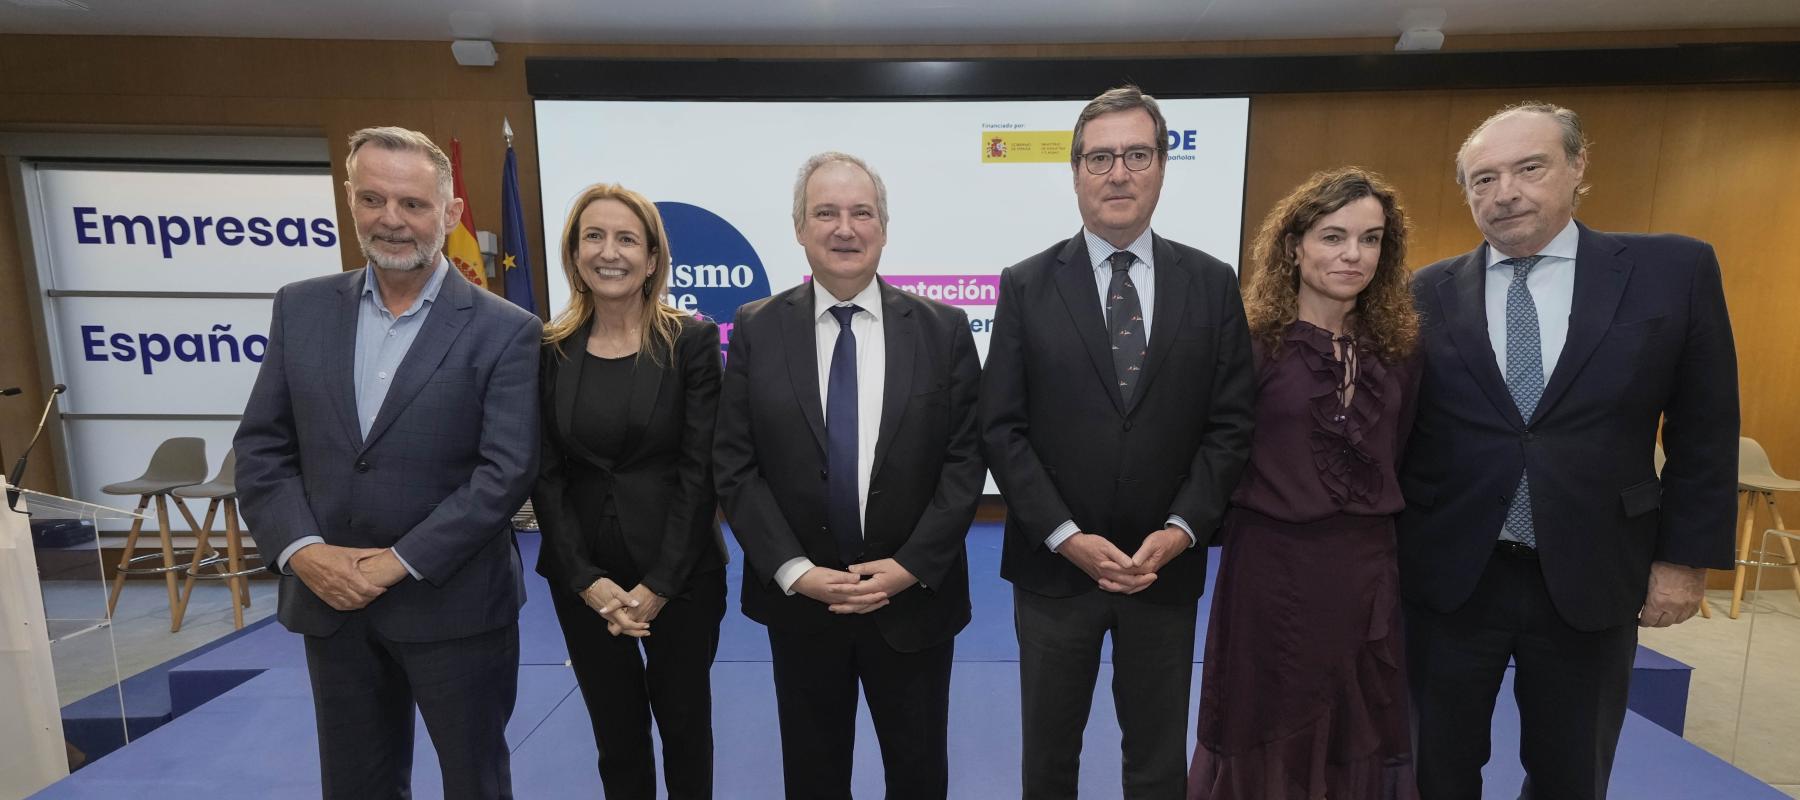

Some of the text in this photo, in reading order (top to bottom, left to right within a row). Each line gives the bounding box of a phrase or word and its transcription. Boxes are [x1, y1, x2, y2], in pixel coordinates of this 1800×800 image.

[73, 206, 337, 259] Empresas
[666, 257, 754, 289] ismo
[900, 278, 996, 300] ntación
[81, 324, 269, 375] Españo
